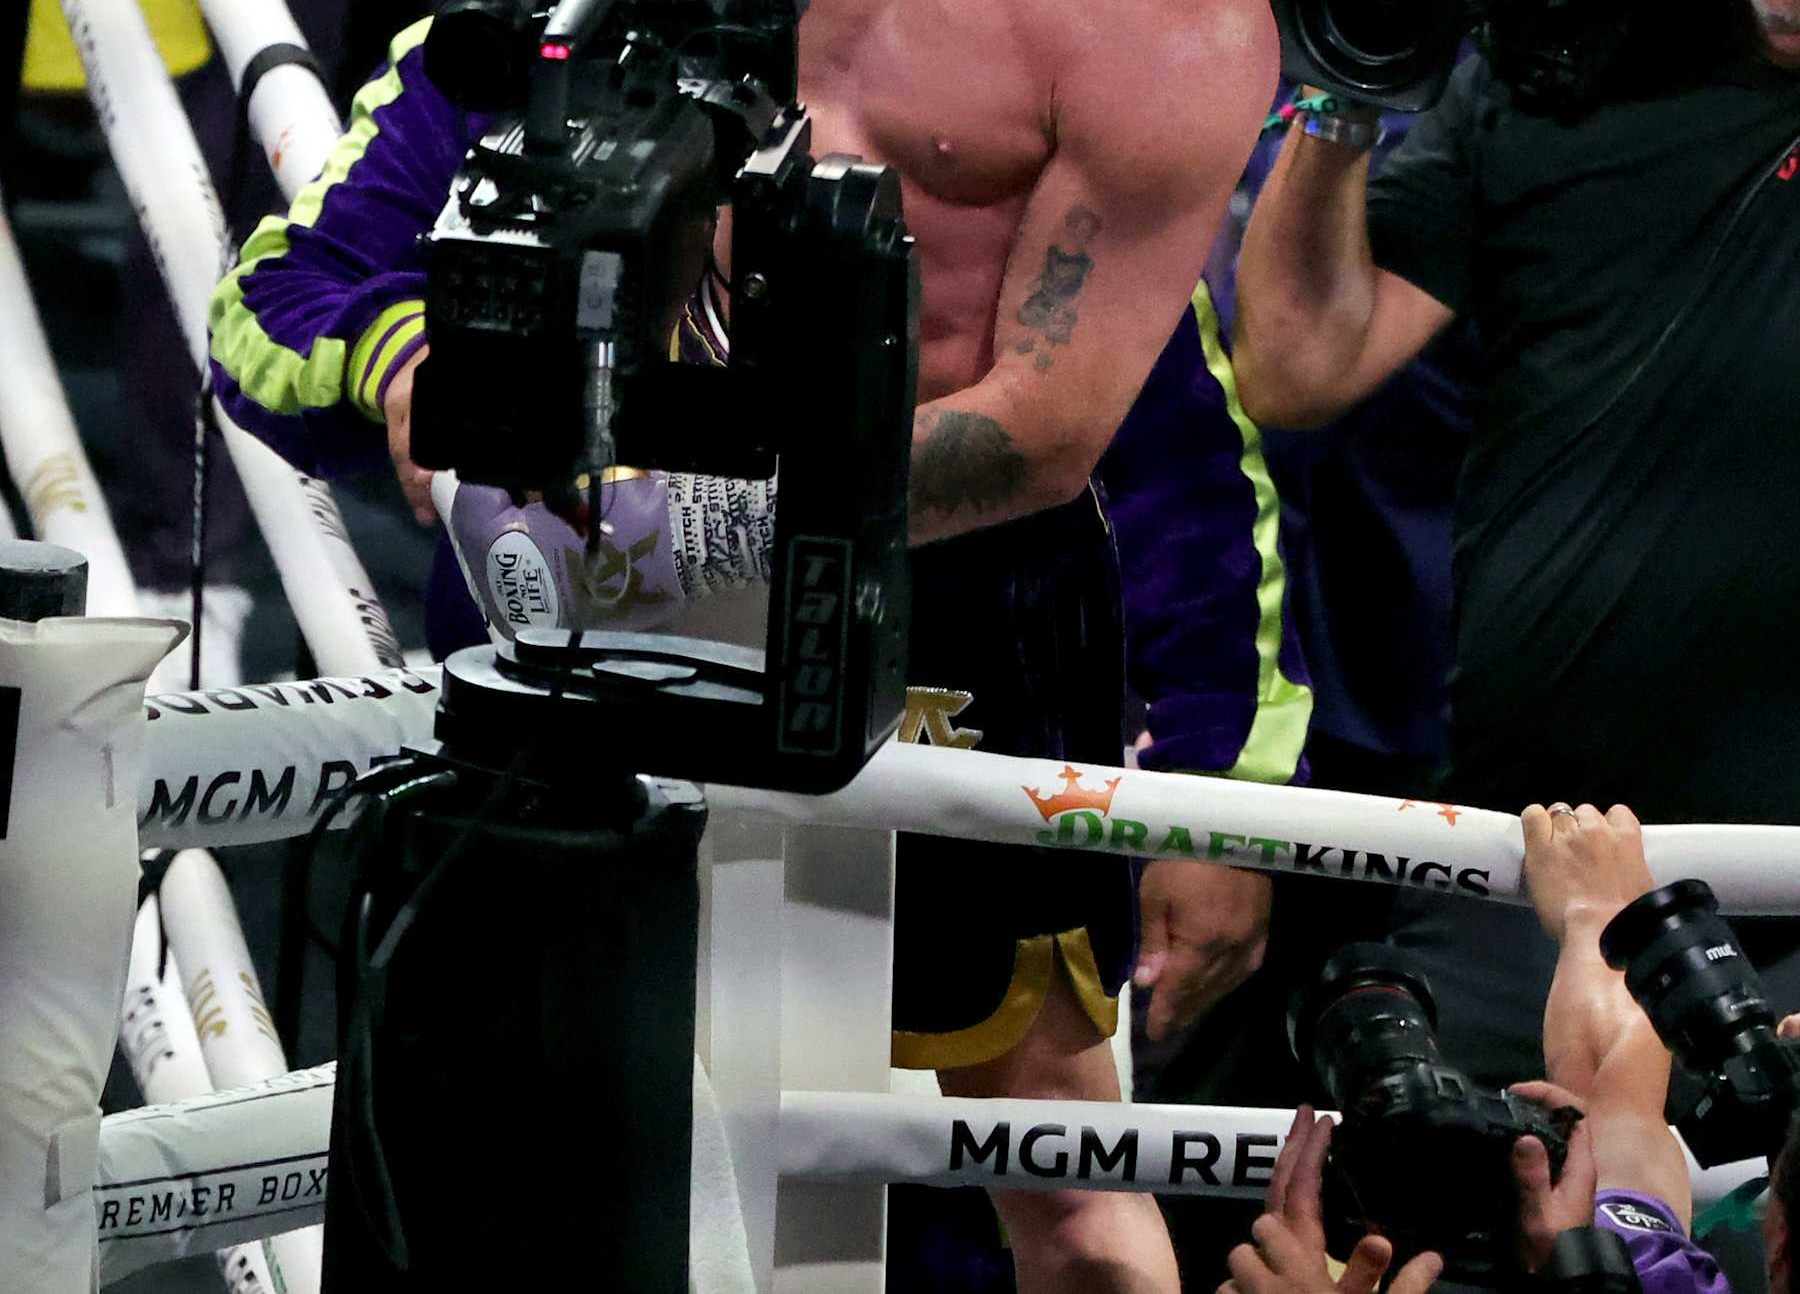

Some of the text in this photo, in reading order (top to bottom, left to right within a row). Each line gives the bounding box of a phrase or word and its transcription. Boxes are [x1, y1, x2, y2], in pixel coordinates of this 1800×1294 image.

[681, 506, 698, 565] STITCH
[495, 552, 531, 625] BOXING
[523, 568, 546, 614] LIFE
[138, 765, 297, 829] MGM
[949, 1118, 1140, 1183] MGM
